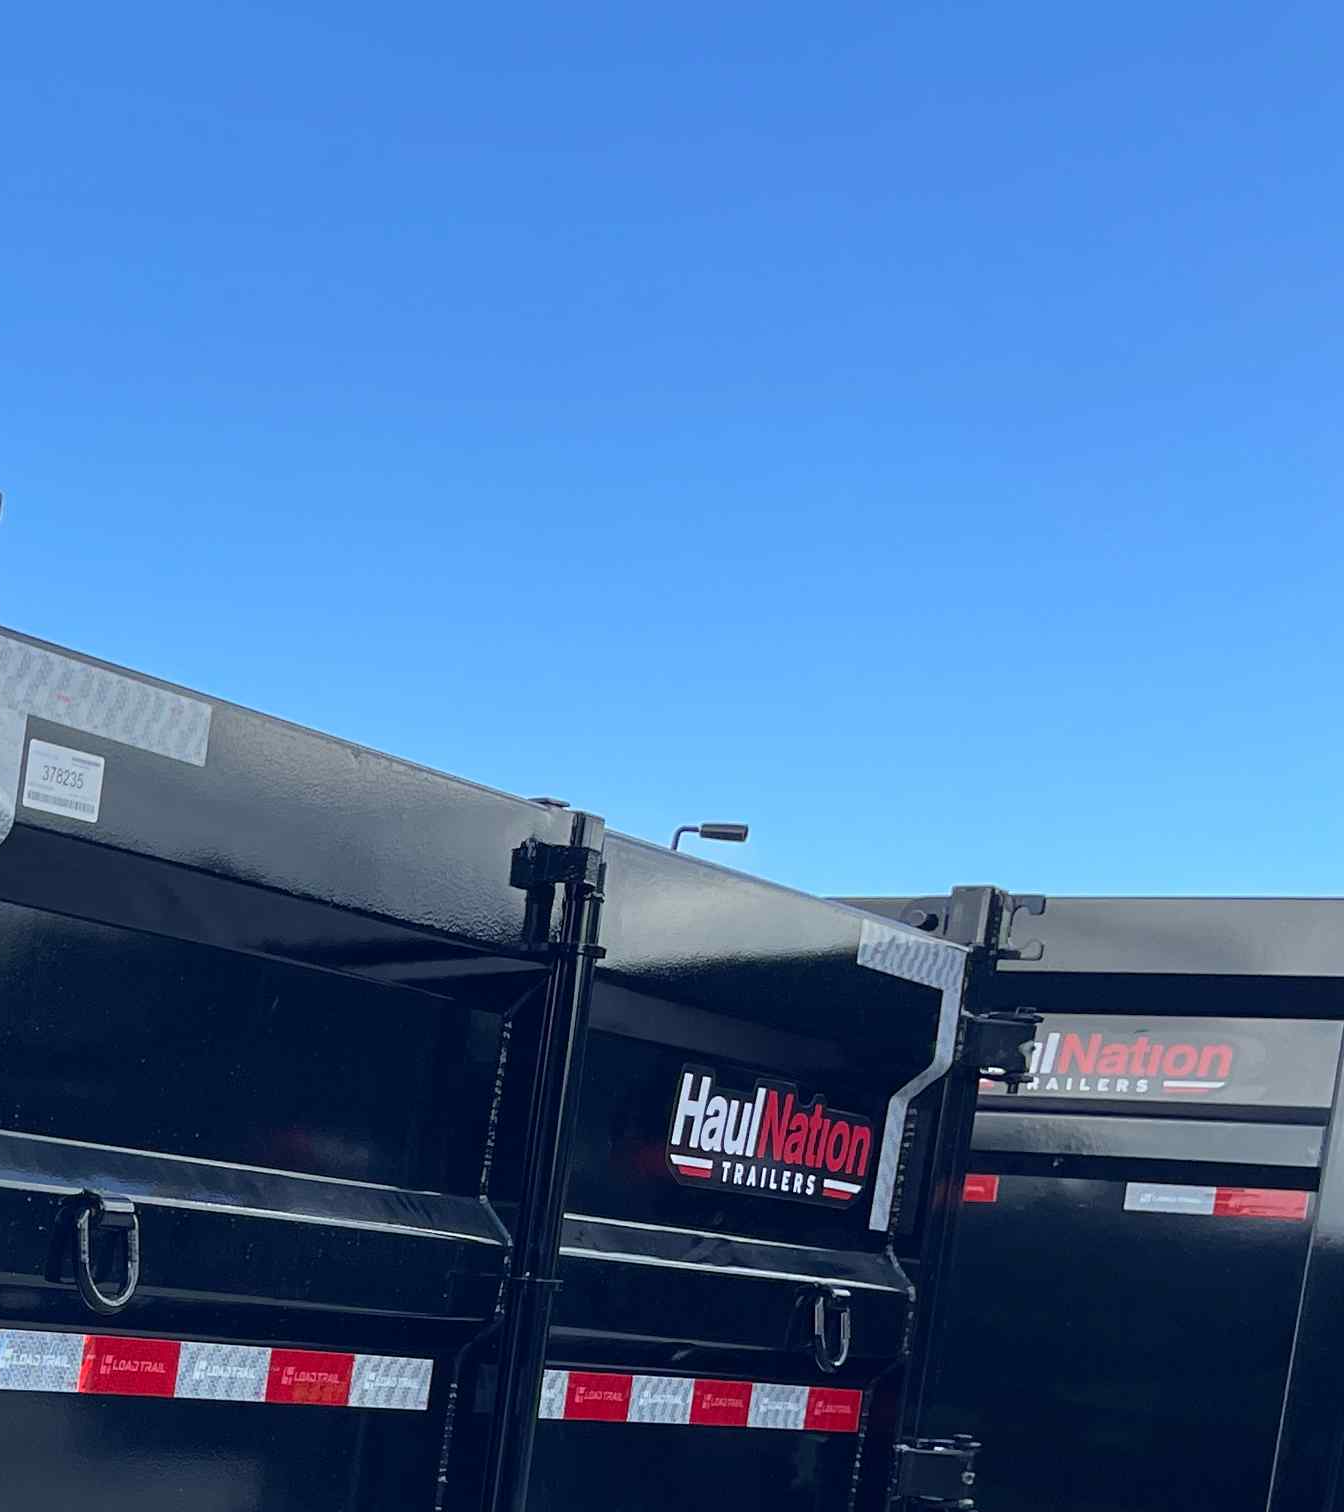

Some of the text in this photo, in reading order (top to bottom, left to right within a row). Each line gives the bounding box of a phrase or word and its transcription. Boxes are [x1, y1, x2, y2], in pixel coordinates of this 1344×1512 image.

[42, 765, 84, 789] 378235
[1029, 1032, 1233, 1078] lNation
[1026, 1077, 1149, 1092] RAILERS
[671, 1072, 872, 1177] HaulNation
[721, 1160, 817, 1196] TRAILERS
